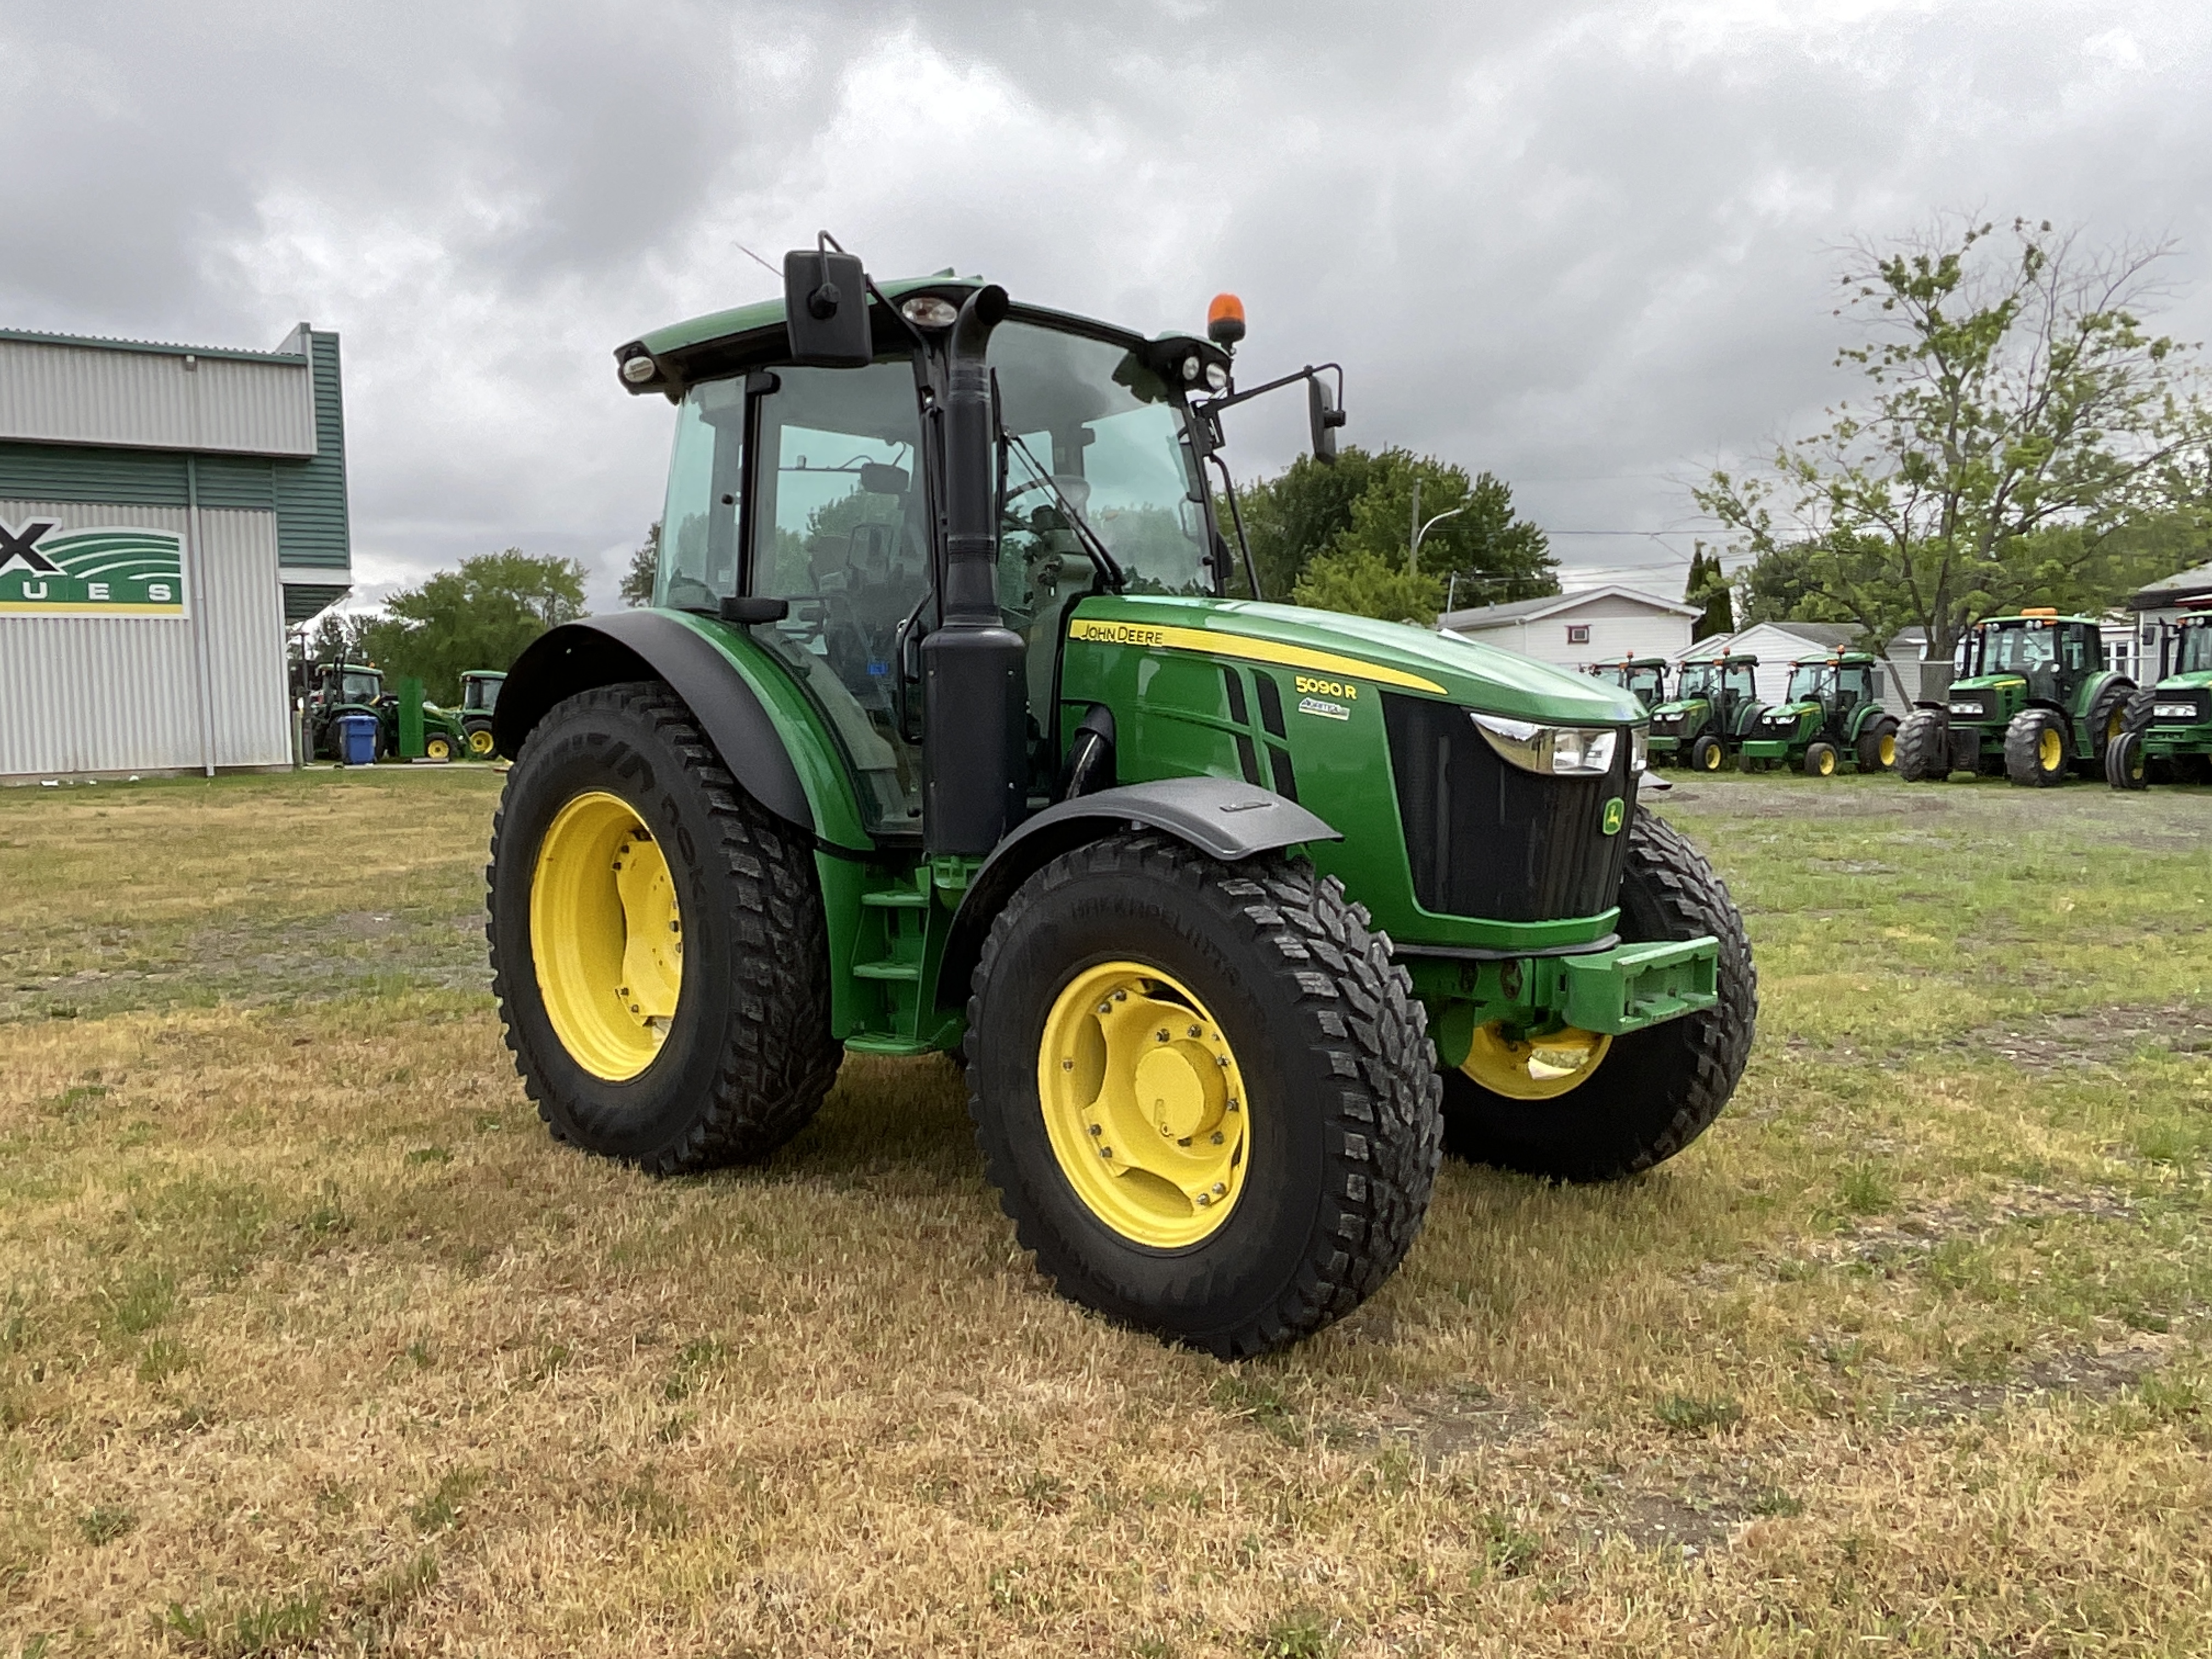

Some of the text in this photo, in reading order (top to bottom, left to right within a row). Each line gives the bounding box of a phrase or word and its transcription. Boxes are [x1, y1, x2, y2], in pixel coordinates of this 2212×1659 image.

[1081, 624, 1163, 644] JOHN DEERE
[1296, 676, 1357, 699] 5090 R
